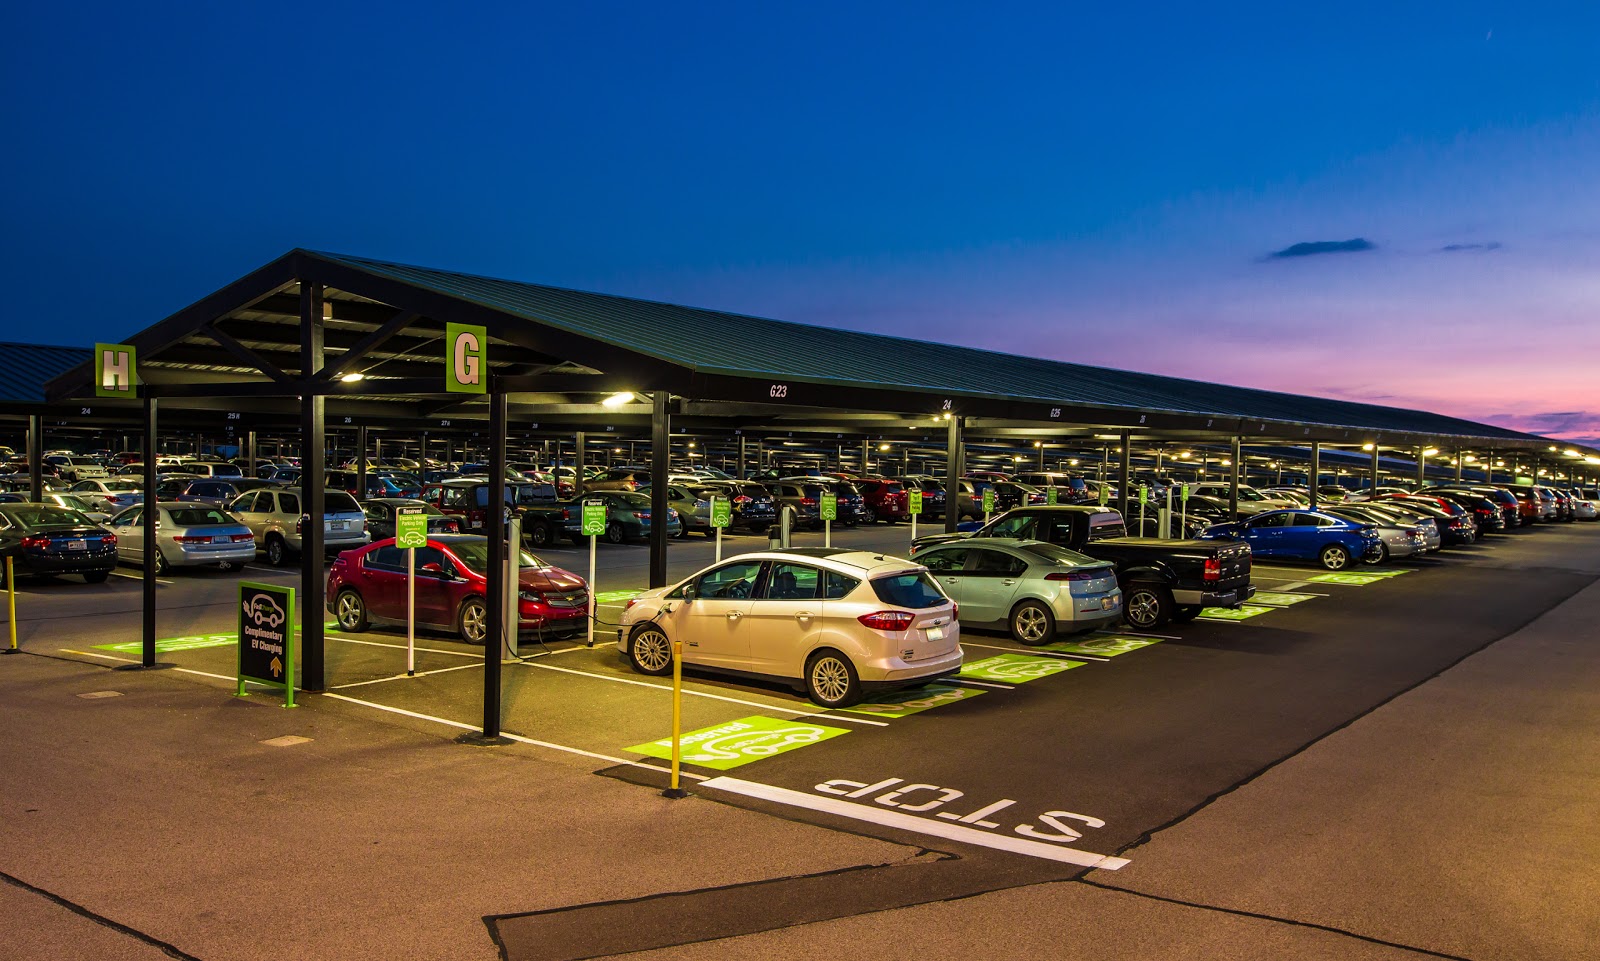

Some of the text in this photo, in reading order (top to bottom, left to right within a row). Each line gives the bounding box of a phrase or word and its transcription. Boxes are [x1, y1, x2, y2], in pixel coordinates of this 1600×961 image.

[454, 332, 480, 386] G
[102, 350, 129, 391] H
[770, 384, 788, 398] G23
[81, 407, 91, 415] 24
[942, 399, 953, 410] 24
[245, 625, 283, 642] Complimentary
[252, 639, 283, 655] EV Charging
[814, 777, 1107, 844] STOP
